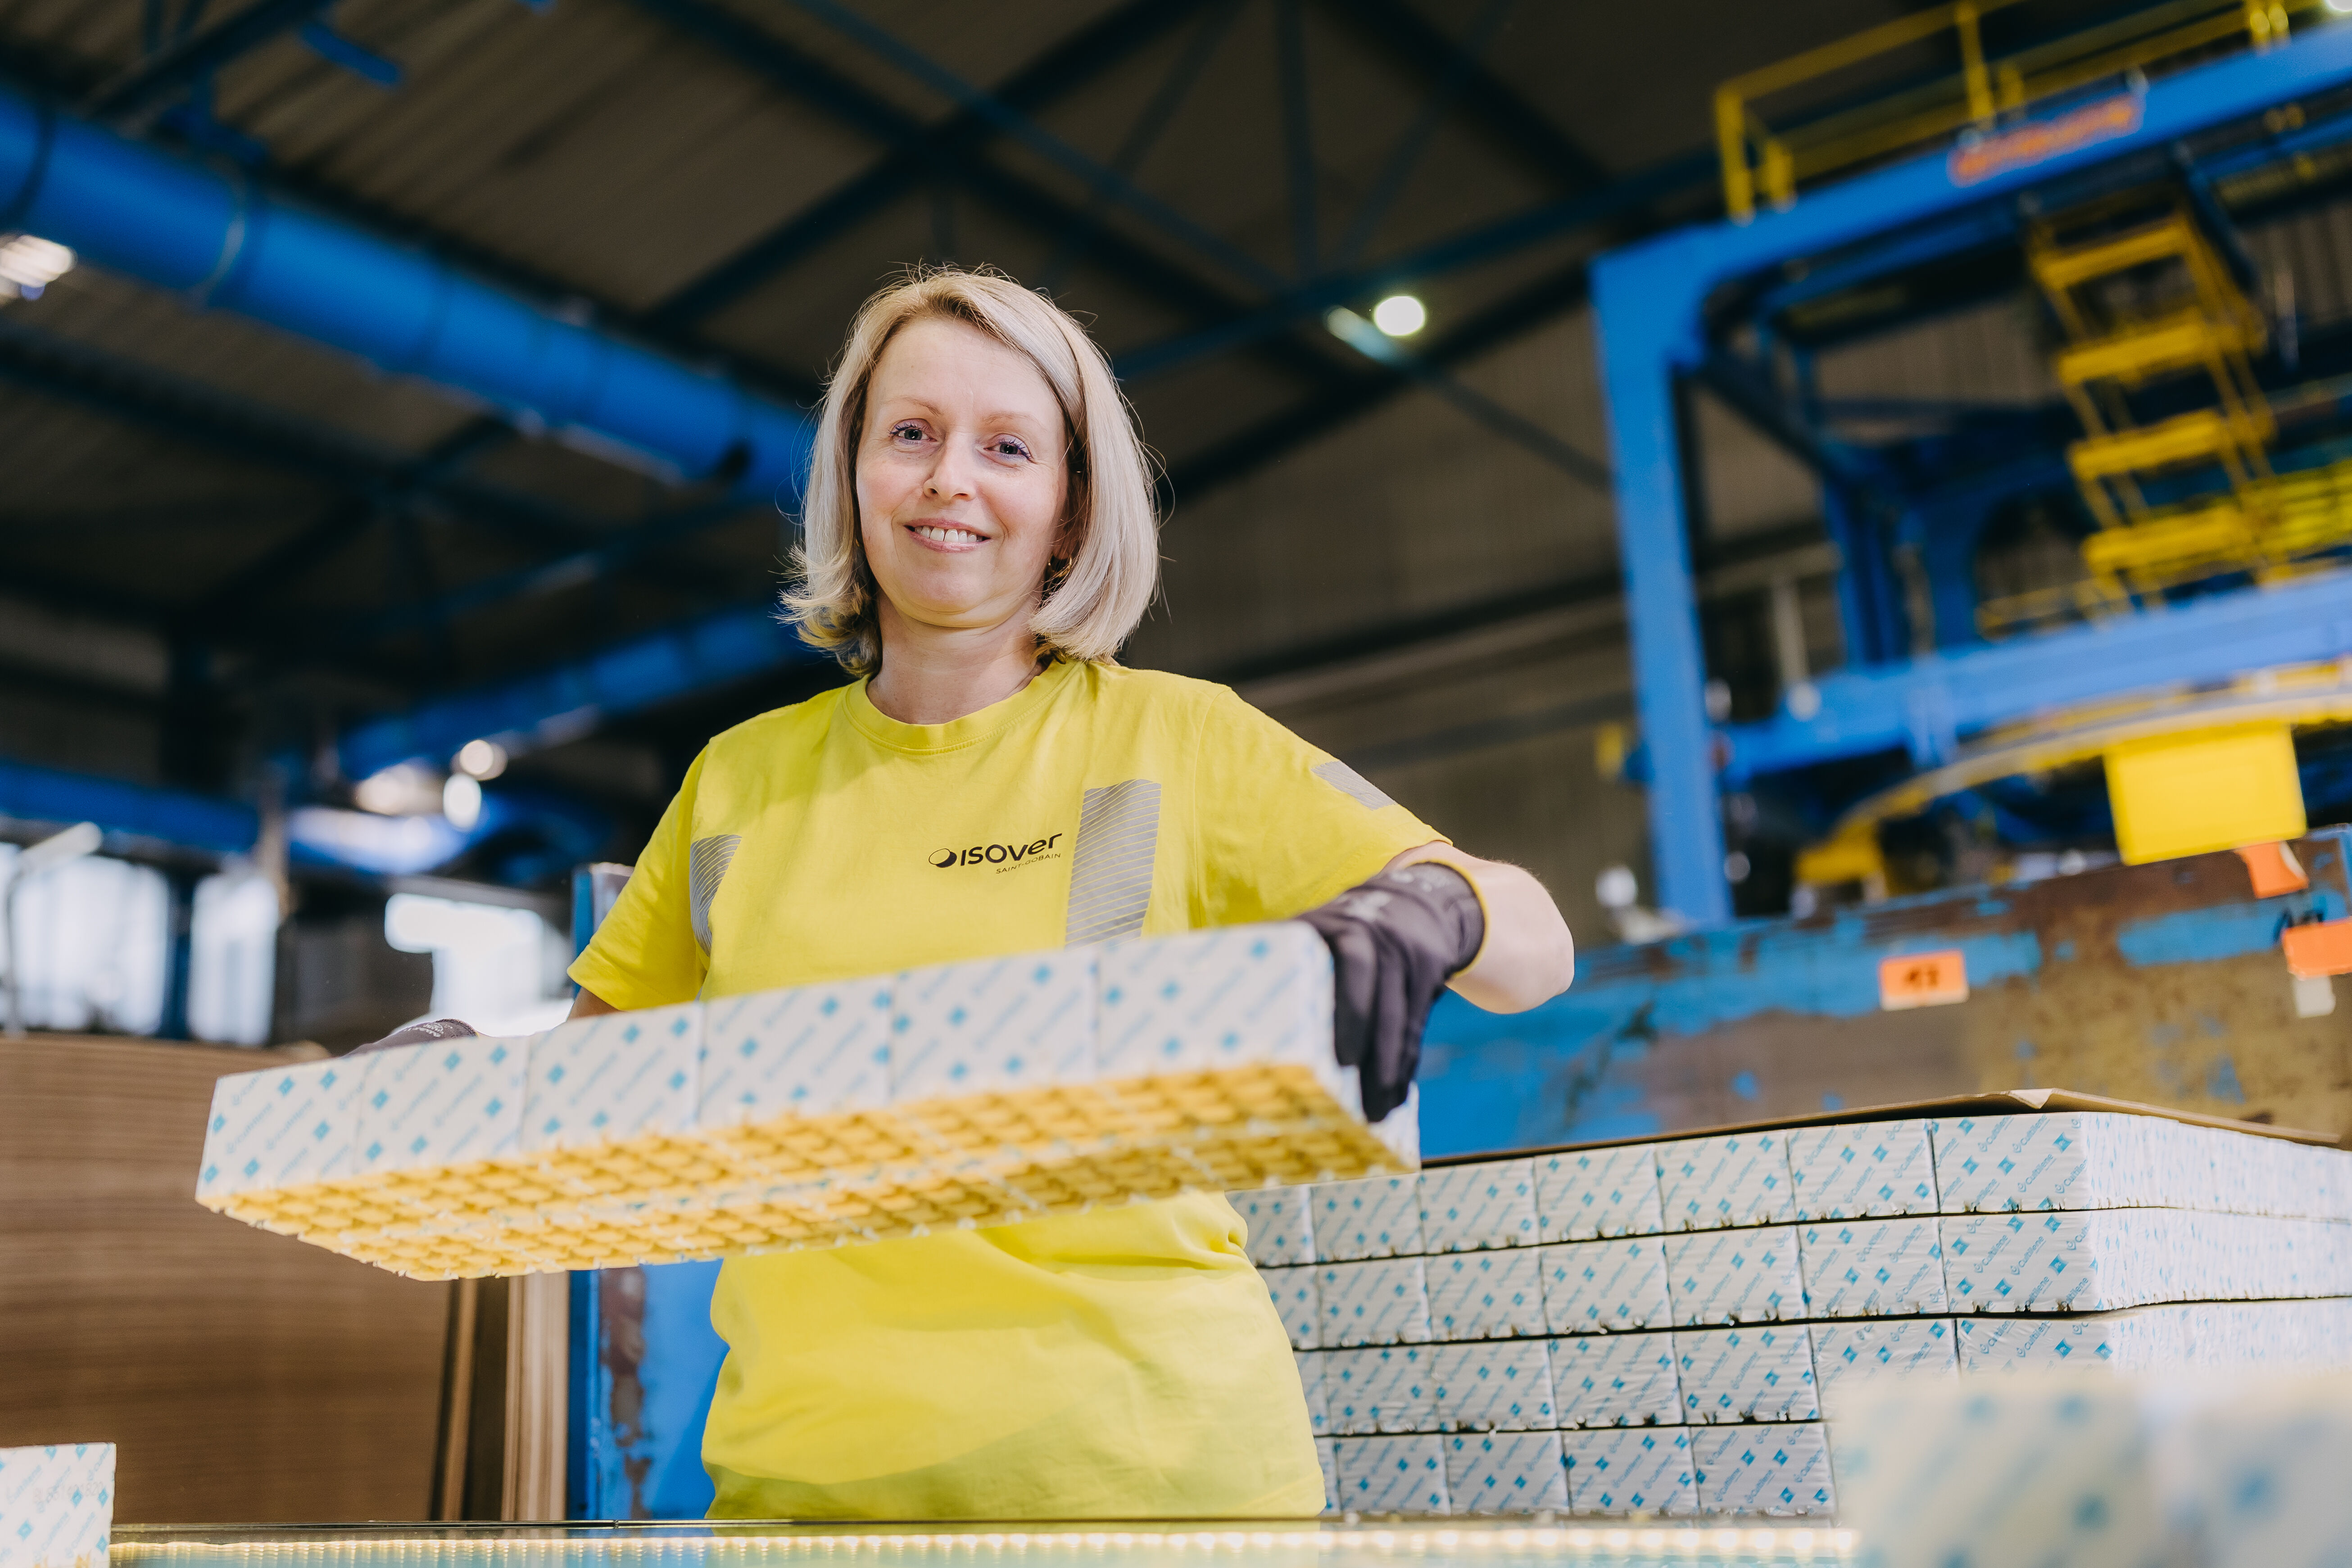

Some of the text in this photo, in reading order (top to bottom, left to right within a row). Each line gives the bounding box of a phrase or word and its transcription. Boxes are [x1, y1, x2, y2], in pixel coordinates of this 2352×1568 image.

[995, 853, 1061, 874] SAINT-GOBAIN
[2026, 1154, 2053, 1184] Cultilene
[1982, 1235, 2008, 1266] Cultilene
[2018, 1236, 2044, 1268] Cultilene
